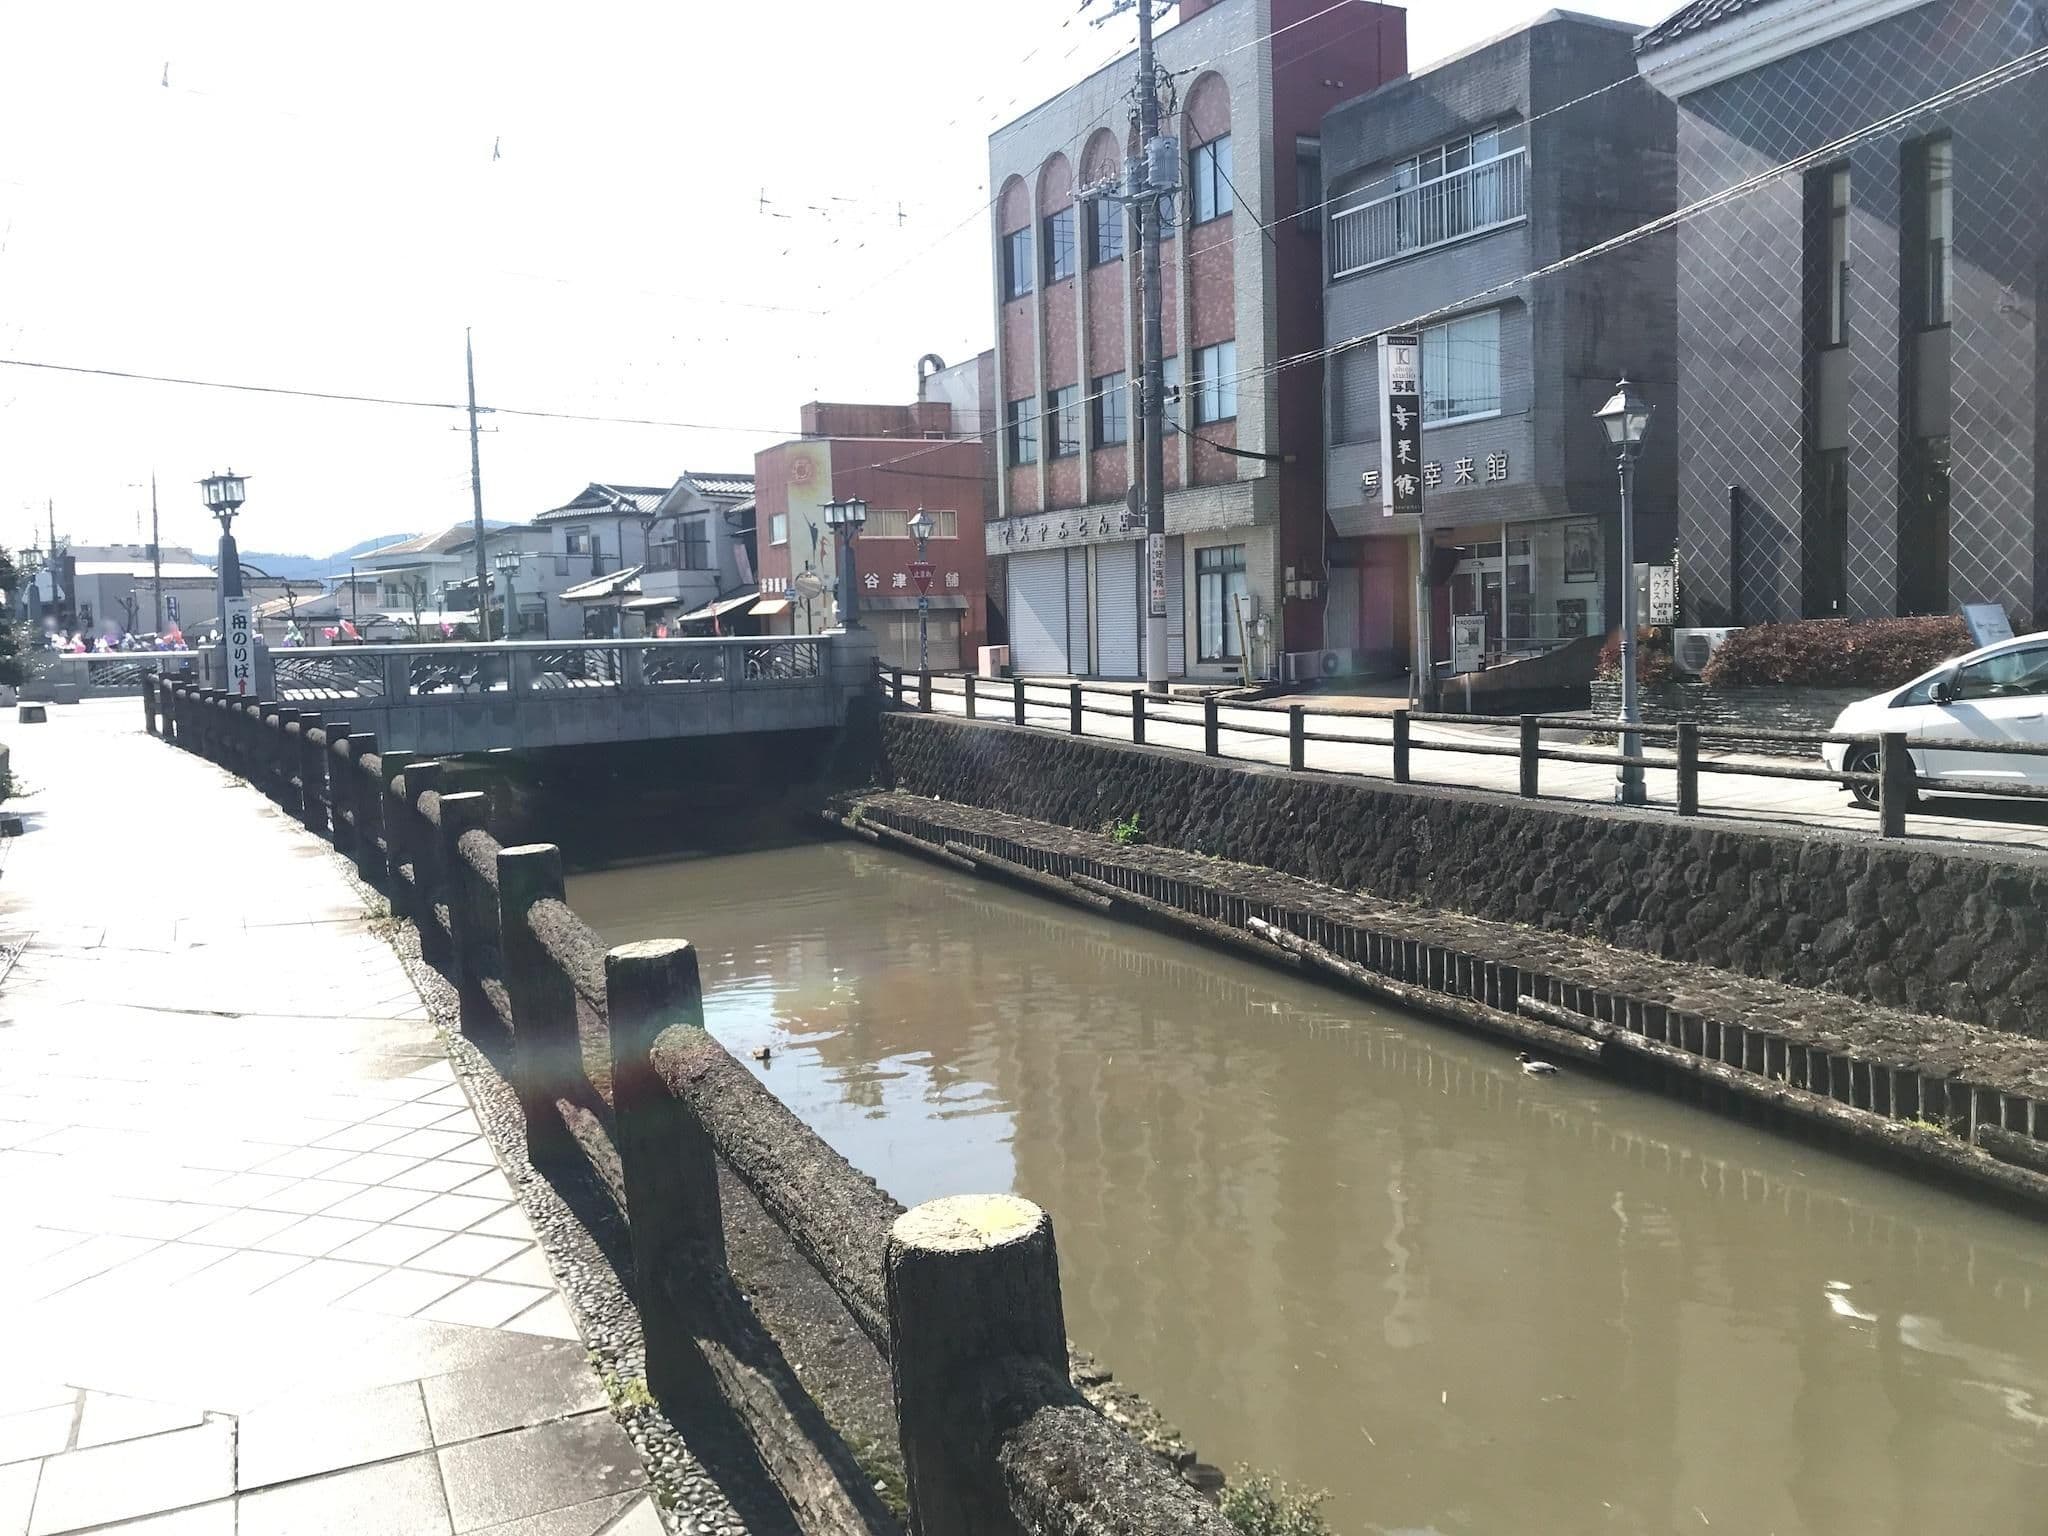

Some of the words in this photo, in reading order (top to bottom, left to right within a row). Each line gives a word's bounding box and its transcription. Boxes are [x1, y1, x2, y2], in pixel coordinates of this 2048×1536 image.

[1392, 380, 1416, 393] 写真
[232, 613, 249, 679] 舟のりば
